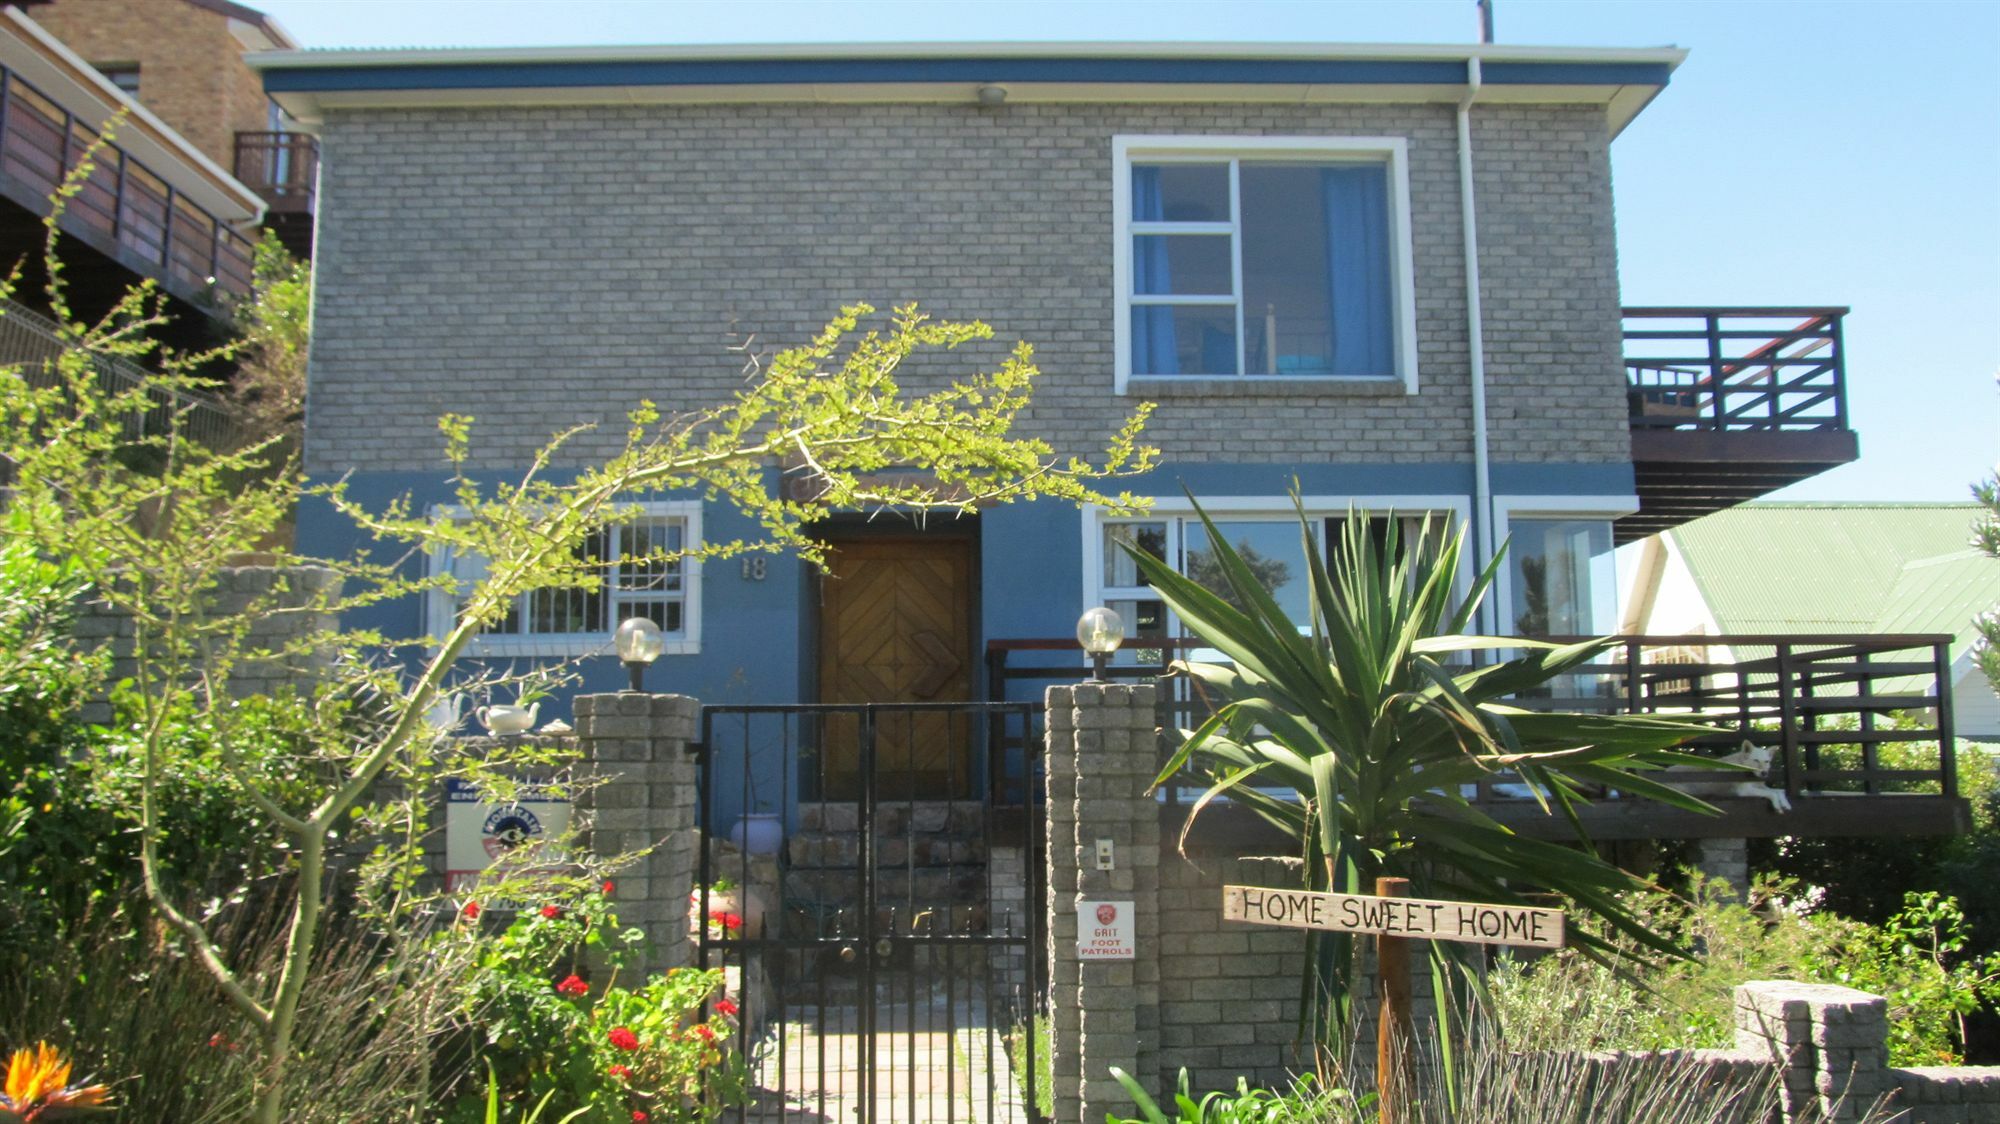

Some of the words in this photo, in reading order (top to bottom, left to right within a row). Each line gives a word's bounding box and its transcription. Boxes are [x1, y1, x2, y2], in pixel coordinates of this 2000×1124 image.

[743, 557, 767, 583] 18
[1243, 889, 1326, 924] HOME
[1340, 898, 1444, 932] SWEET
[1458, 907, 1548, 941] HOME
